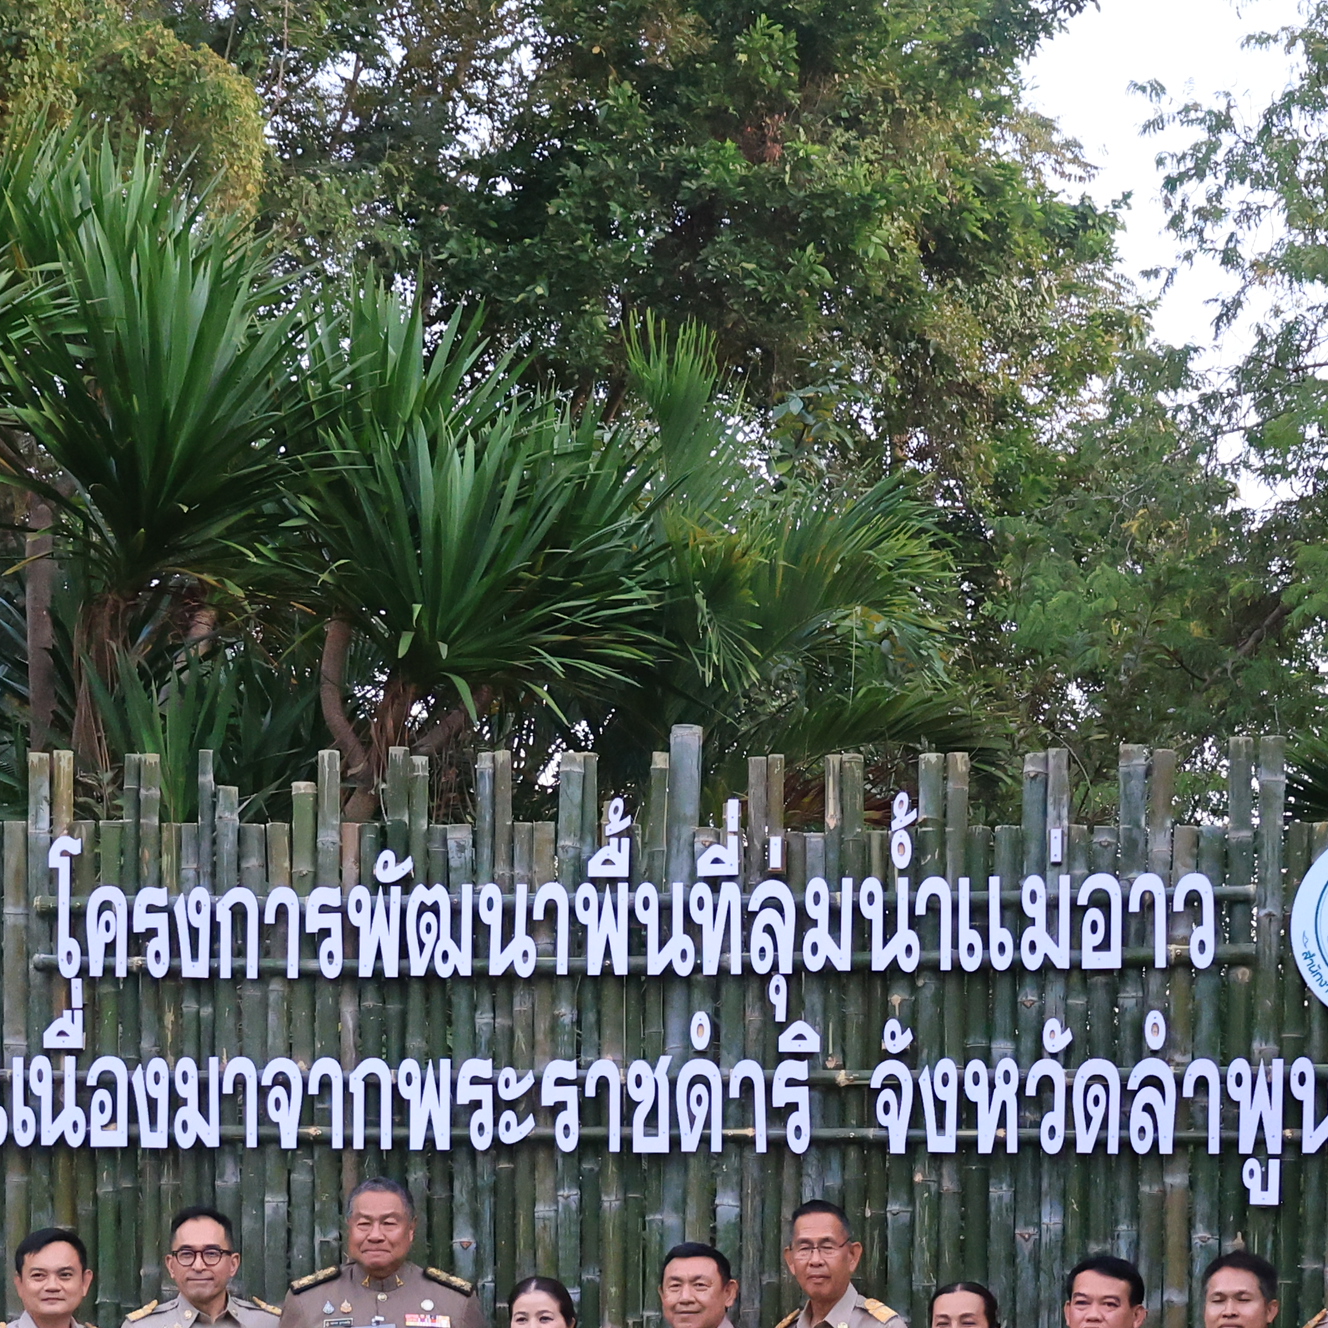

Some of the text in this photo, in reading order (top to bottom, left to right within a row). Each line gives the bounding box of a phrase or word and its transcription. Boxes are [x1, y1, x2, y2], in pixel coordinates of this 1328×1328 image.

[47, 790, 1219, 1023] โครงการพัฒนาพื้นที่ลุ่มน้ำแม่อาว
